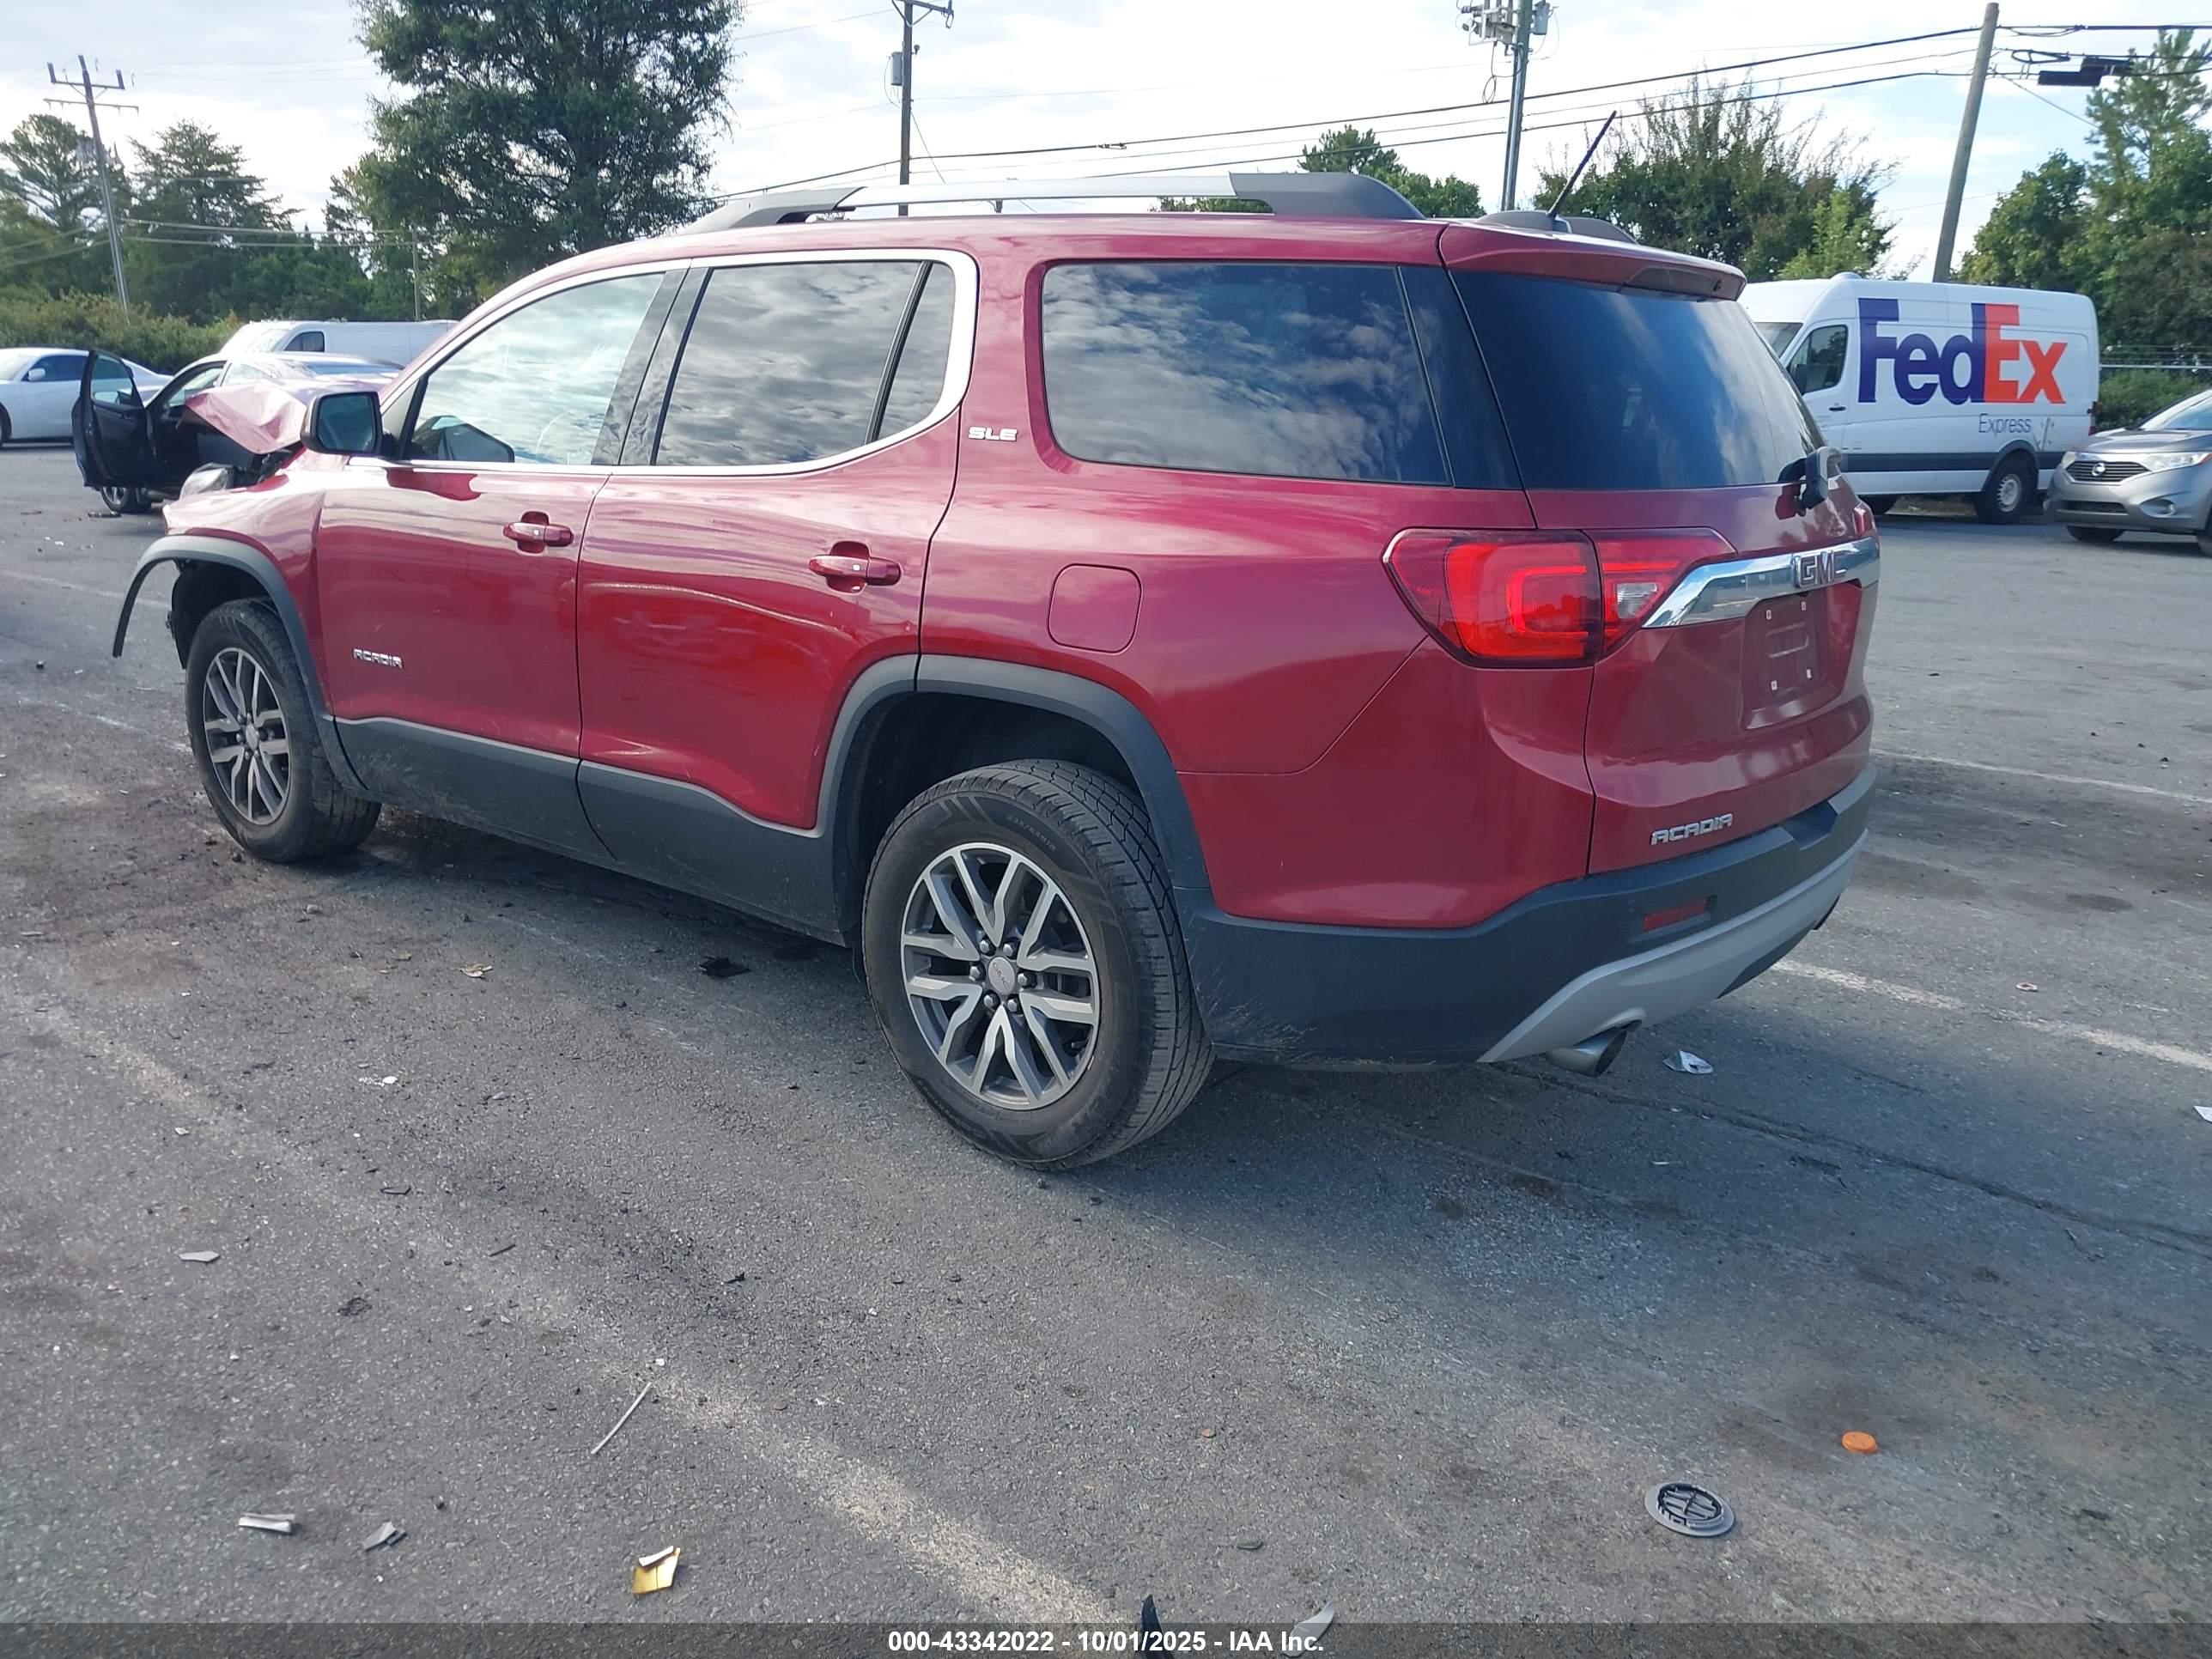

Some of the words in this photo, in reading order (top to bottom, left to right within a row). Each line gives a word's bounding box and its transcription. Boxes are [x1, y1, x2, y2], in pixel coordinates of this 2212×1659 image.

[1857, 297, 2069, 405] FedEx
[968, 426, 1018, 441] SLE
[1978, 413, 2032, 437] Express
[353, 648, 403, 669] ACADIA
[1650, 813, 1734, 846] ACADIA
